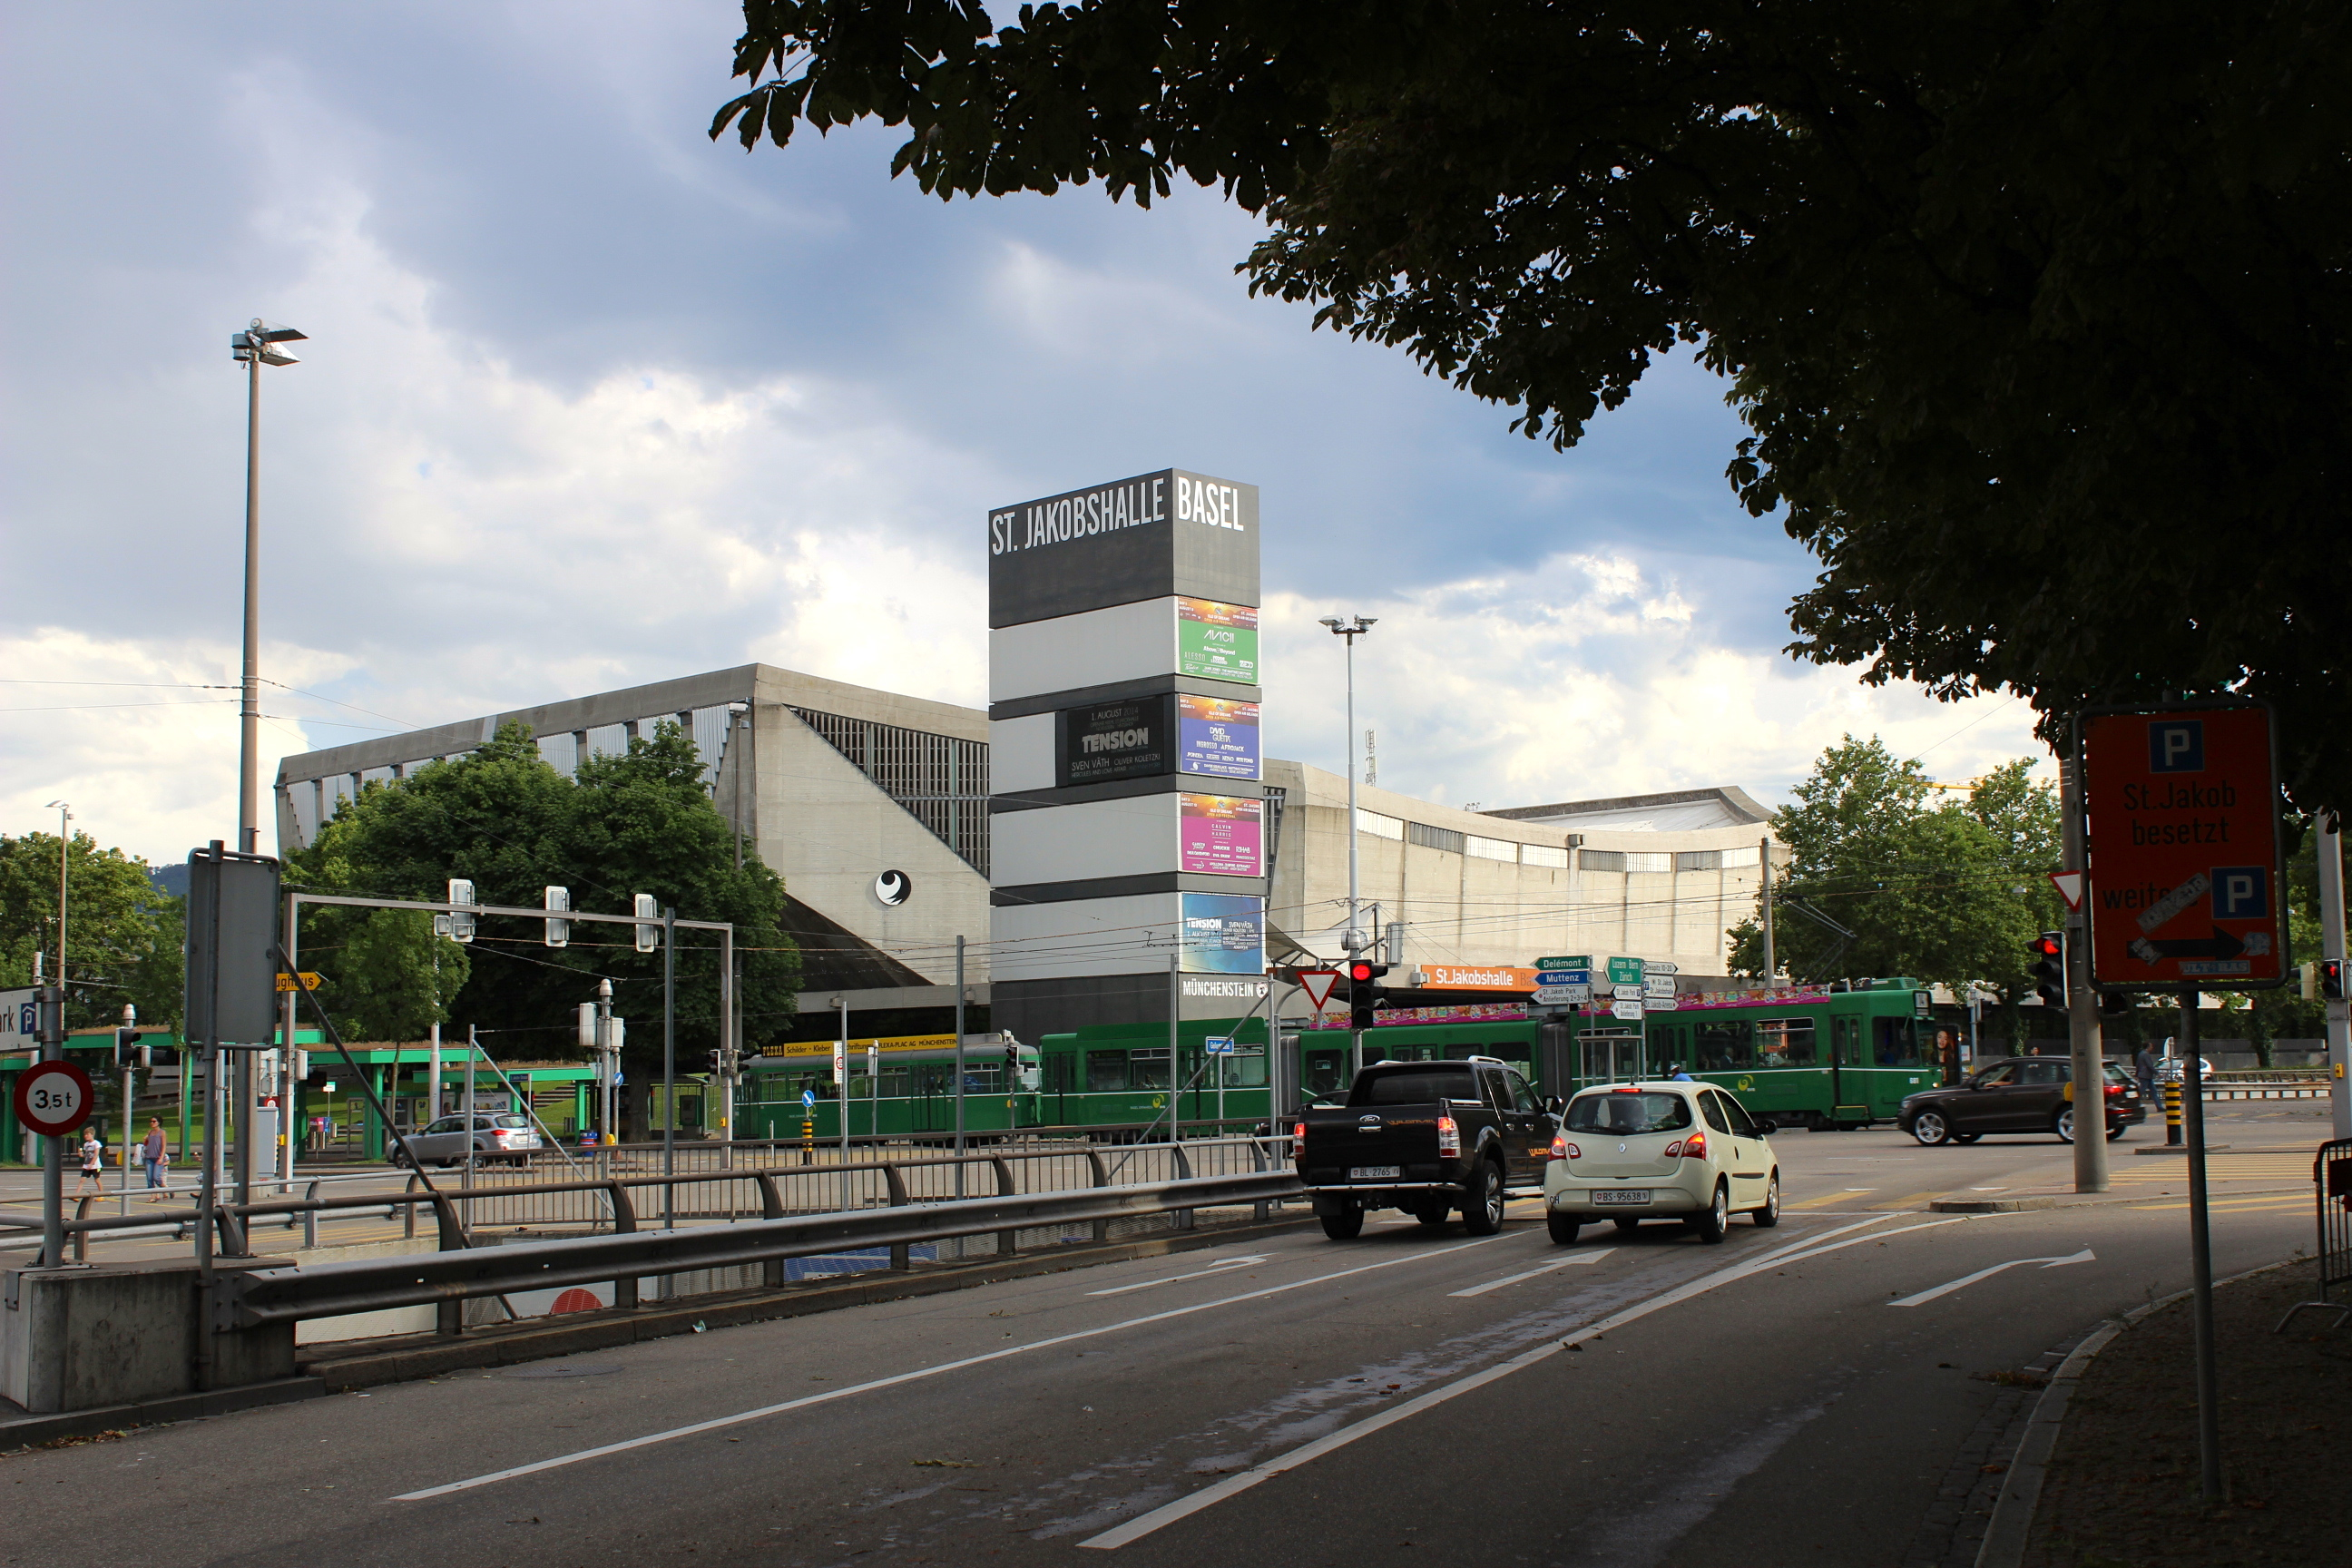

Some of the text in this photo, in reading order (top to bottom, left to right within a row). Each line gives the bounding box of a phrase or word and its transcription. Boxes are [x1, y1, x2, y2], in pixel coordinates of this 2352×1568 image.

[1178, 476, 1244, 532] BASEL
[992, 477, 1165, 555] ST. JAKOBSHALLE
[1203, 629, 1234, 643] AVICII
[1184, 652, 1206, 662] ALESSO
[1098, 709, 1122, 720] AUGUST
[1123, 707, 1139, 716] 2014
[1082, 727, 1149, 753] TENSION
[1196, 740, 1245, 752] INGROSSO AFROJACK
[2164, 729, 2190, 767] P
[1113, 753, 1161, 766] OLIVER KOLETZKI
[1072, 761, 1090, 771] SVEN
[1072, 770, 1091, 779] HERCULES
[2132, 816, 2230, 846] besetzt
[2227, 875, 2254, 913] P
[1186, 917, 1222, 929] TENSION
[1544, 958, 1582, 968] Delémont
[1612, 958, 1639, 970] Luzern Bern
[1546, 972, 1580, 983] Muttenz
[1620, 971, 1632, 982] Zürich
[1182, 977, 1254, 997] MÜNCHENSTEIN
[1544, 995, 1569, 1004] Anlieferung
[813, 1044, 830, 1053] Kleber
[34, 1089, 72, 1110] 3,5 t
